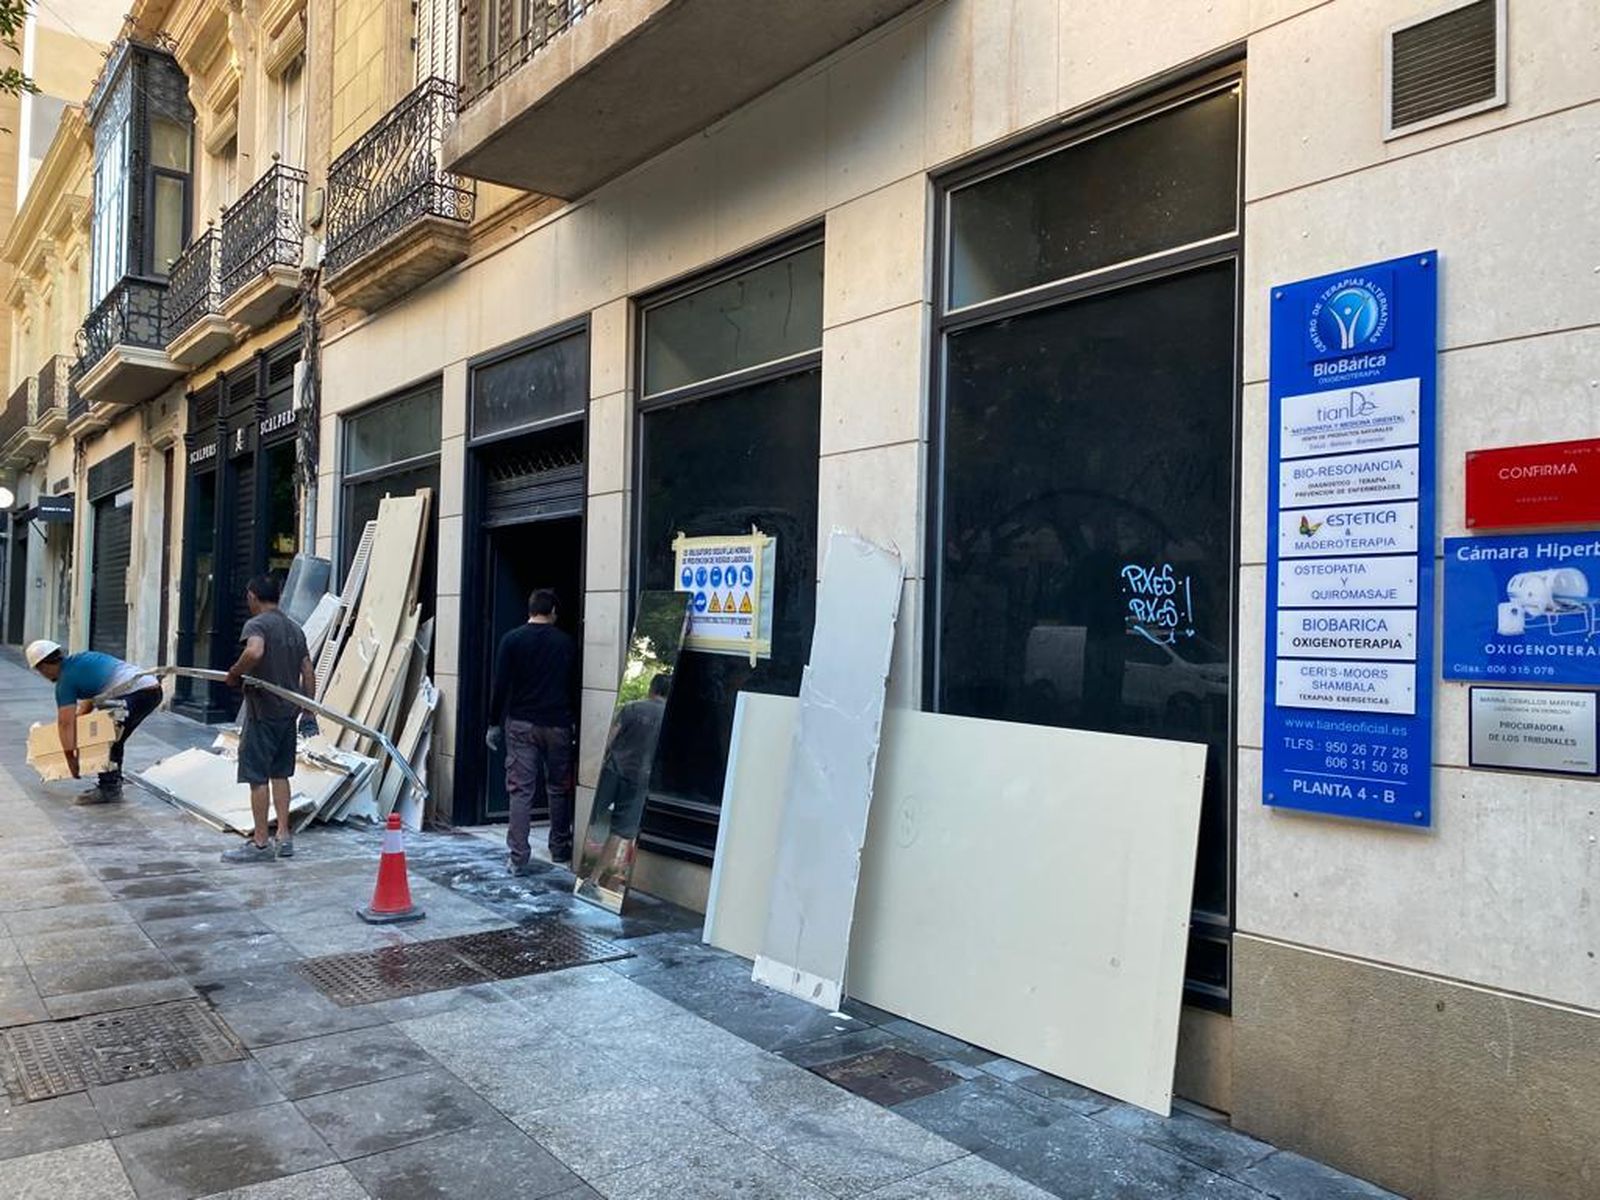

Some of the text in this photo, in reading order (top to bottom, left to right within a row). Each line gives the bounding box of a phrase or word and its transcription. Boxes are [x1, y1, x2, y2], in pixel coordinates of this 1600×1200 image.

[1312, 302, 1322, 316] DE
[1293, 460, 1402, 479] BIO-RESONANCIA
[1499, 462, 1578, 479] CONFIRMA
[1359, 476, 1386, 485] TERAPIA
[1348, 484, 1400, 494] ENFERMEDADES
[1326, 510, 1397, 526] ESTETICA
[1345, 528, 1351, 536] &
[1294, 537, 1396, 550] MADEROTERAPIA
[1457, 544, 1529, 561] Cámara
[1294, 564, 1366, 575] OSTEOPATIA
[1340, 577, 1348, 585] Y
[1311, 589, 1398, 600] QUIROMASAJE
[1302, 618, 1388, 632] BIOBARICA
[1292, 637, 1402, 649] OXIGENOTERAPIA
[1485, 644, 1600, 656] OXIGENOTERA
[1312, 680, 1376, 692] SHAMBALA
[1299, 694, 1389, 704] TERAPIAS ENERGETICAS
[1284, 718, 1407, 737] www.tiandeoficial.es
[1499, 720, 1564, 732] PROCURADORA
[1488, 733, 1577, 746] DE LOS TRIBUNALES
[1325, 742, 1348, 754] 950
[1352, 743, 1367, 756] 26
[1372, 745, 1388, 757] 77
[1392, 747, 1408, 760] 28
[1325, 756, 1409, 776] 606 31 50 78
[1293, 779, 1352, 799] PLANTA
[1357, 788, 1367, 800] 4
[1384, 790, 1396, 803] B
